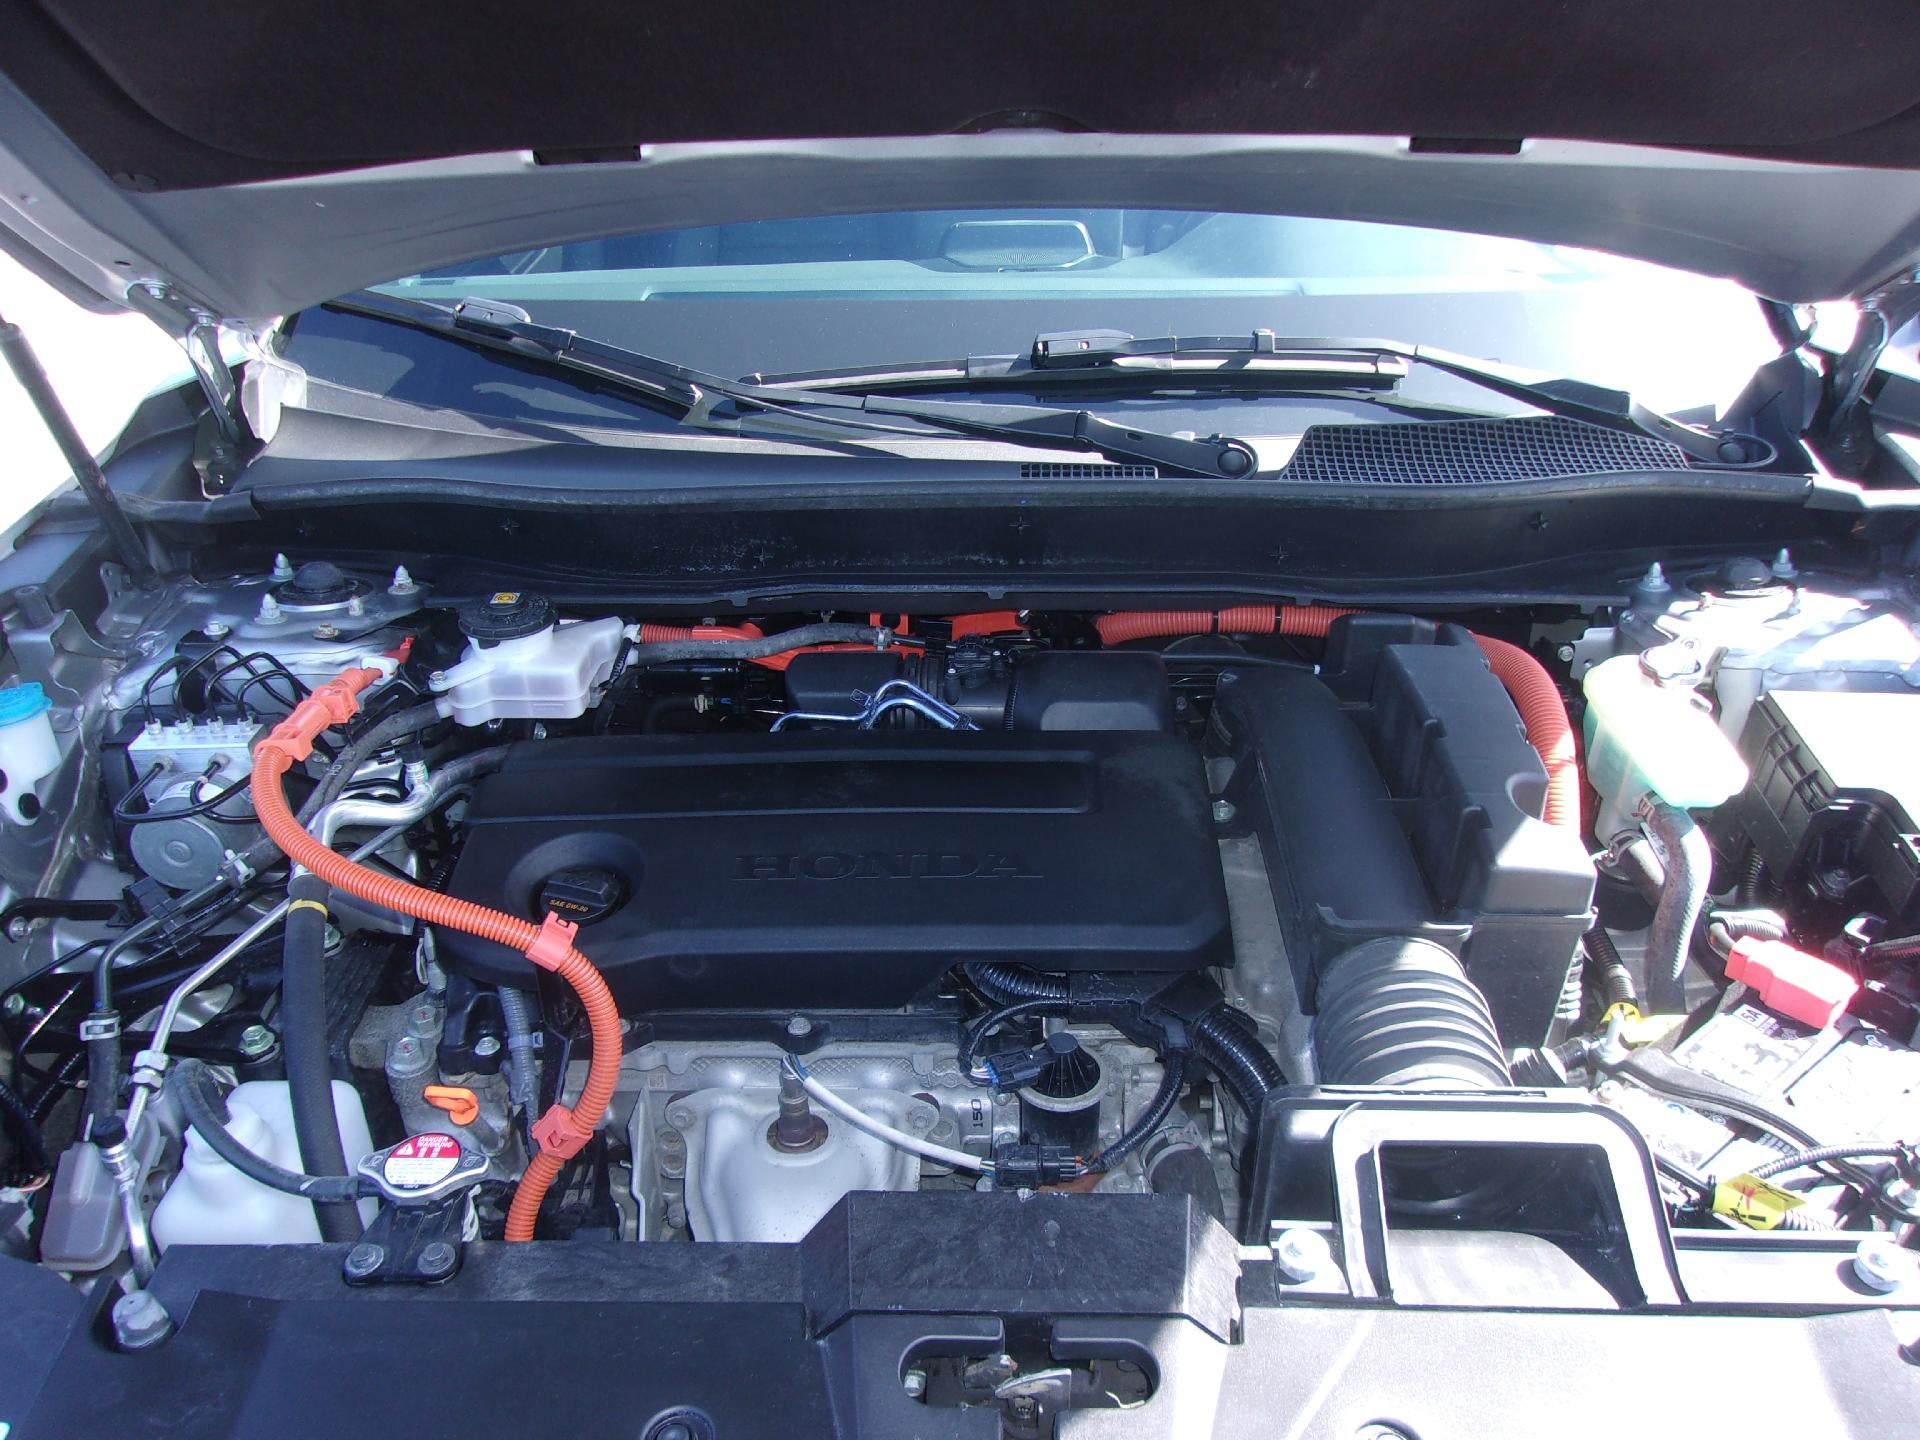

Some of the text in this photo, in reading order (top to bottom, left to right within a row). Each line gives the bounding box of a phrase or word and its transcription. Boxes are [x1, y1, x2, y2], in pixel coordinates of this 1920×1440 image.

[732, 853, 1044, 880] HONDA
[549, 899, 566, 908] SAE
[971, 1098, 983, 1128] 150
[416, 1141, 454, 1149] WARNING
